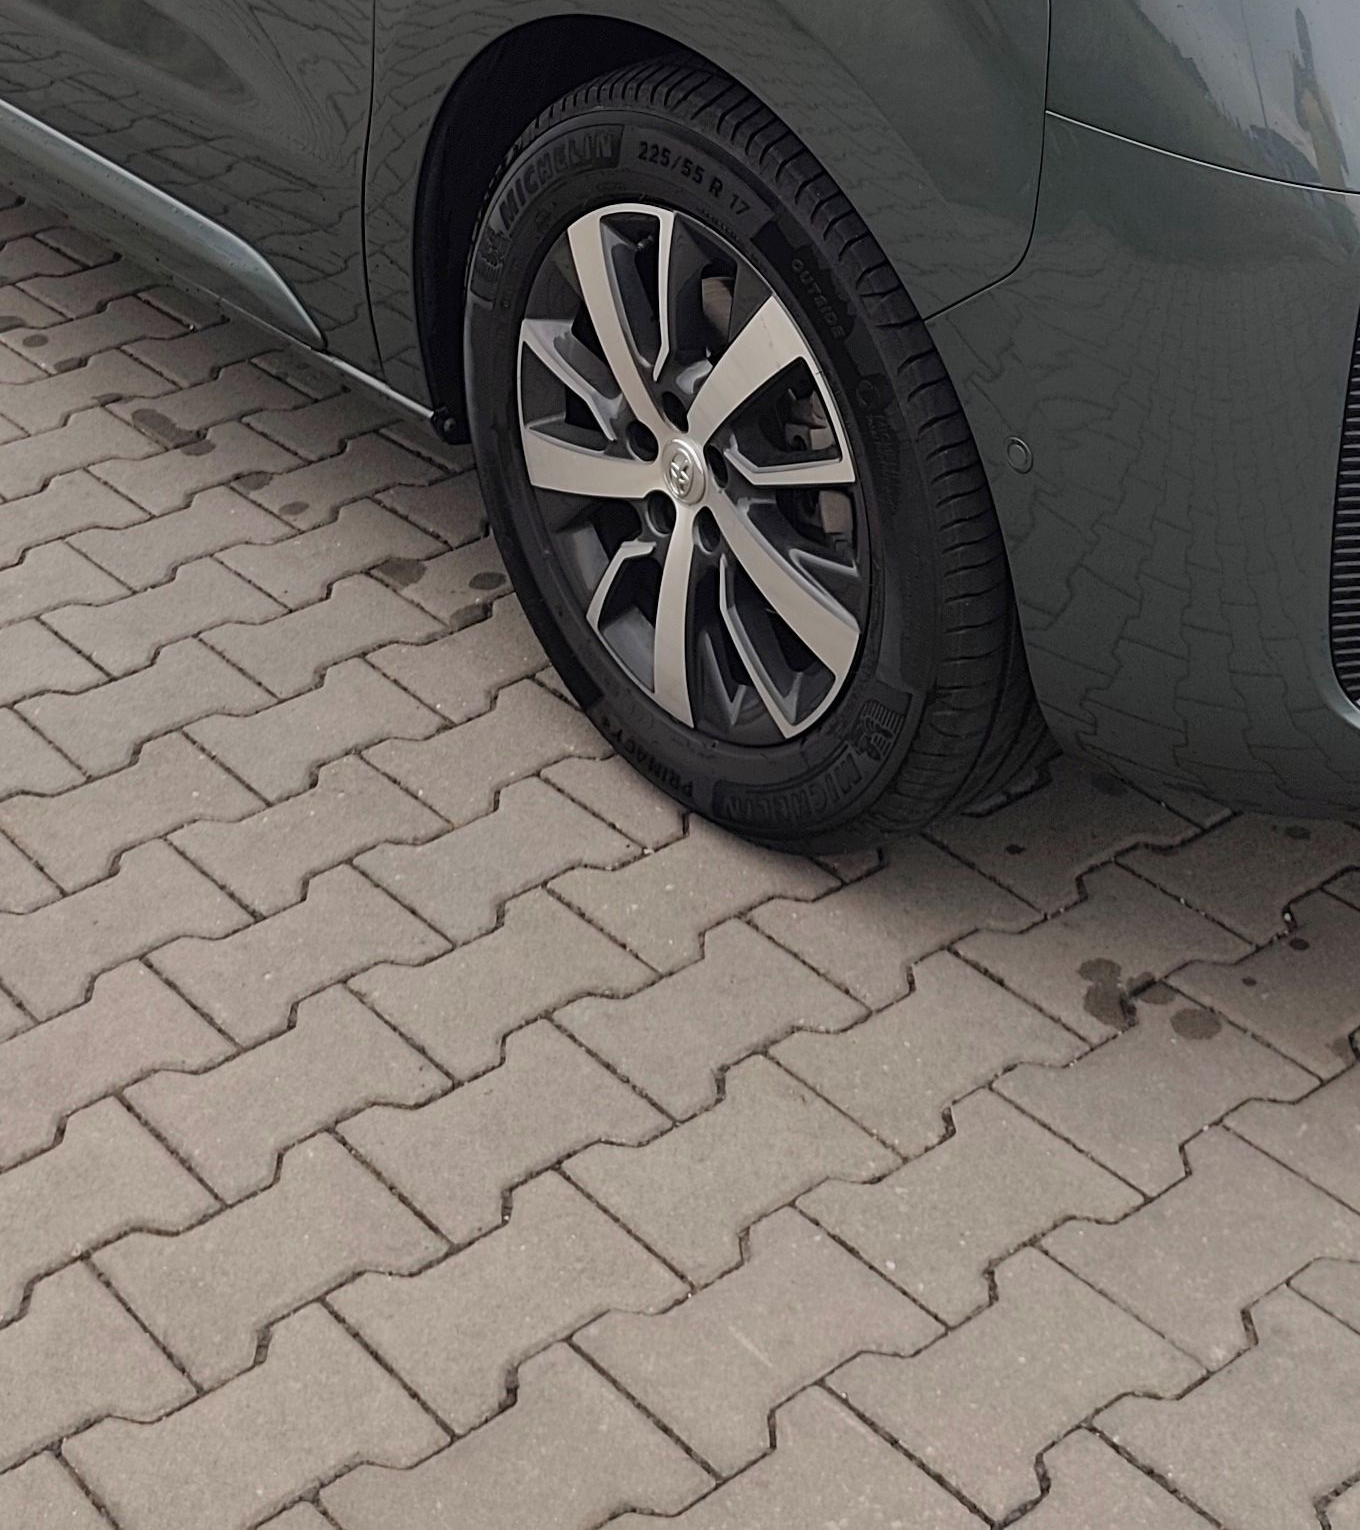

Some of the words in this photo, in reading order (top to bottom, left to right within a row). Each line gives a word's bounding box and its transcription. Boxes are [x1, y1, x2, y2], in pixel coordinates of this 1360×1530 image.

[500, 132, 615, 229] MICHELIN
[637, 140, 706, 184] 225/55
[709, 176, 724, 198] R
[729, 194, 751, 215] 17
[791, 257, 846, 339] OUTSIDE
[610, 728, 694, 798] PRIMACY
[722, 752, 863, 825] MICHELIN
